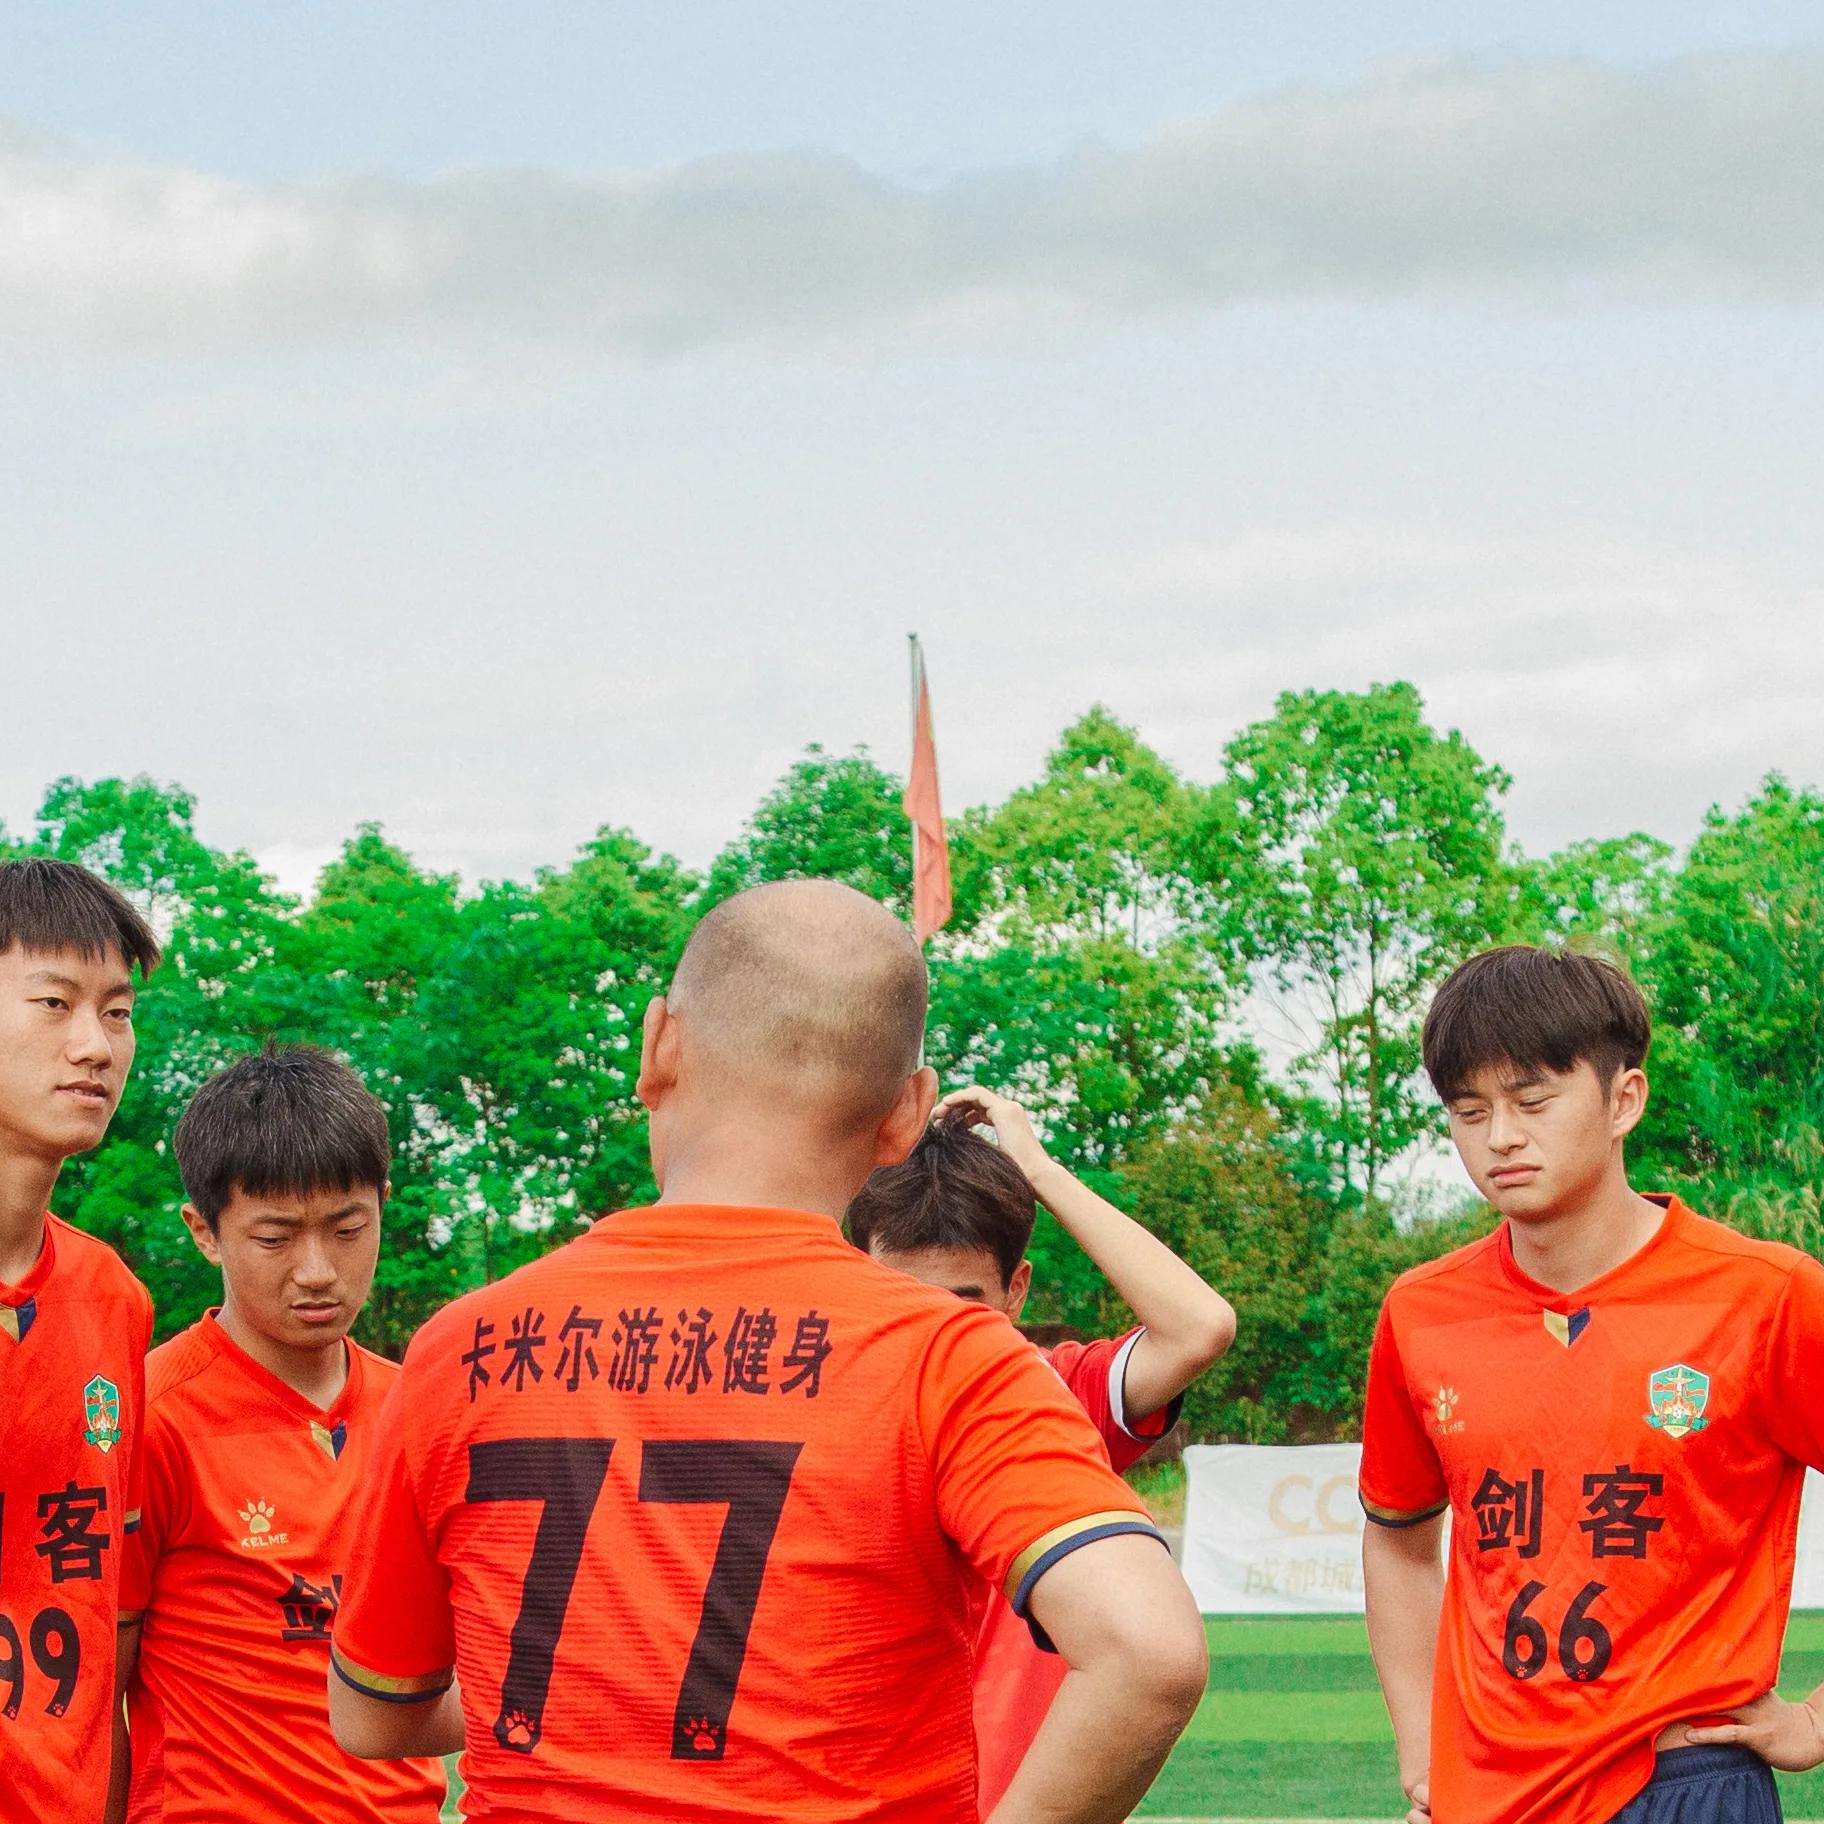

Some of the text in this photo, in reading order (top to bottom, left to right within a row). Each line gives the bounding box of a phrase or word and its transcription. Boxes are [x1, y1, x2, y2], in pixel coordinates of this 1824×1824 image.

[461, 1305, 833, 1403] 卡米尔游泳健身
[240, 1533, 289, 1549] KELME
[1471, 1464, 1666, 1560] 剑客
[465, 1437, 806, 1761] 77
[1502, 1579, 1614, 1684] 66
